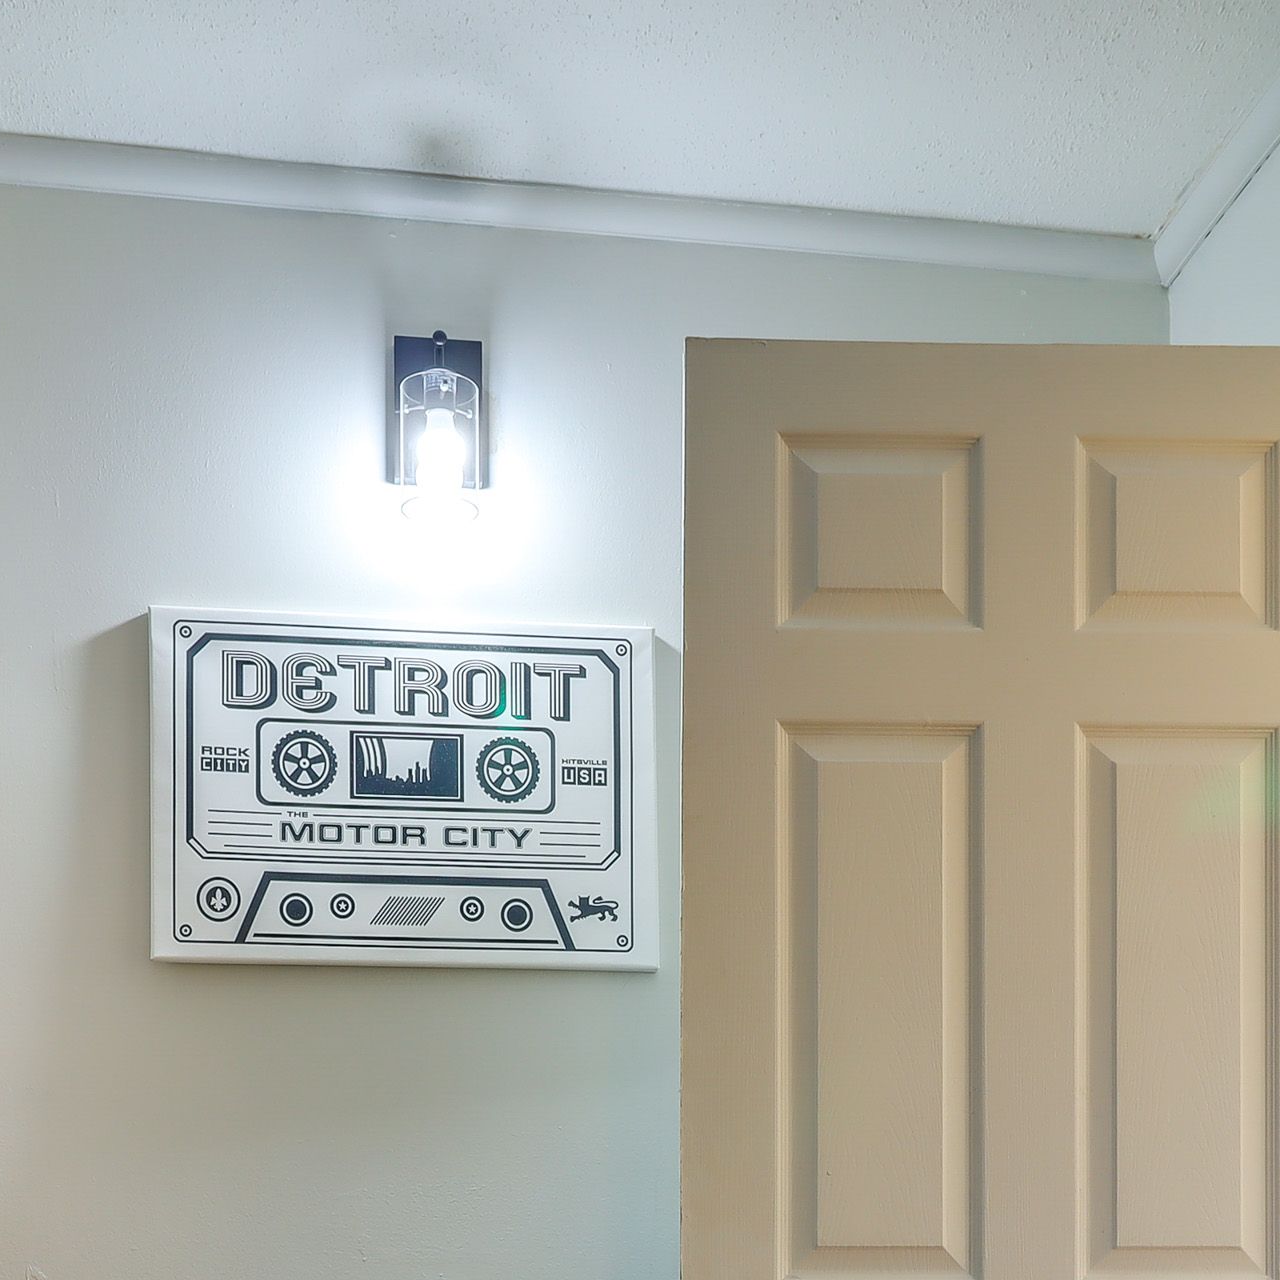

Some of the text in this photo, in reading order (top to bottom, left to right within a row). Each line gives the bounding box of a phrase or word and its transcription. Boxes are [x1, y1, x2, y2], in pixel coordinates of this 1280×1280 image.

[222, 650, 587, 721] DETROIT
[201, 746, 250, 757] ROCK
[202, 758, 248, 772] CITY
[563, 768, 606, 785] USA
[287, 810, 309, 818] THE
[280, 822, 533, 848] MOTOR CITY
